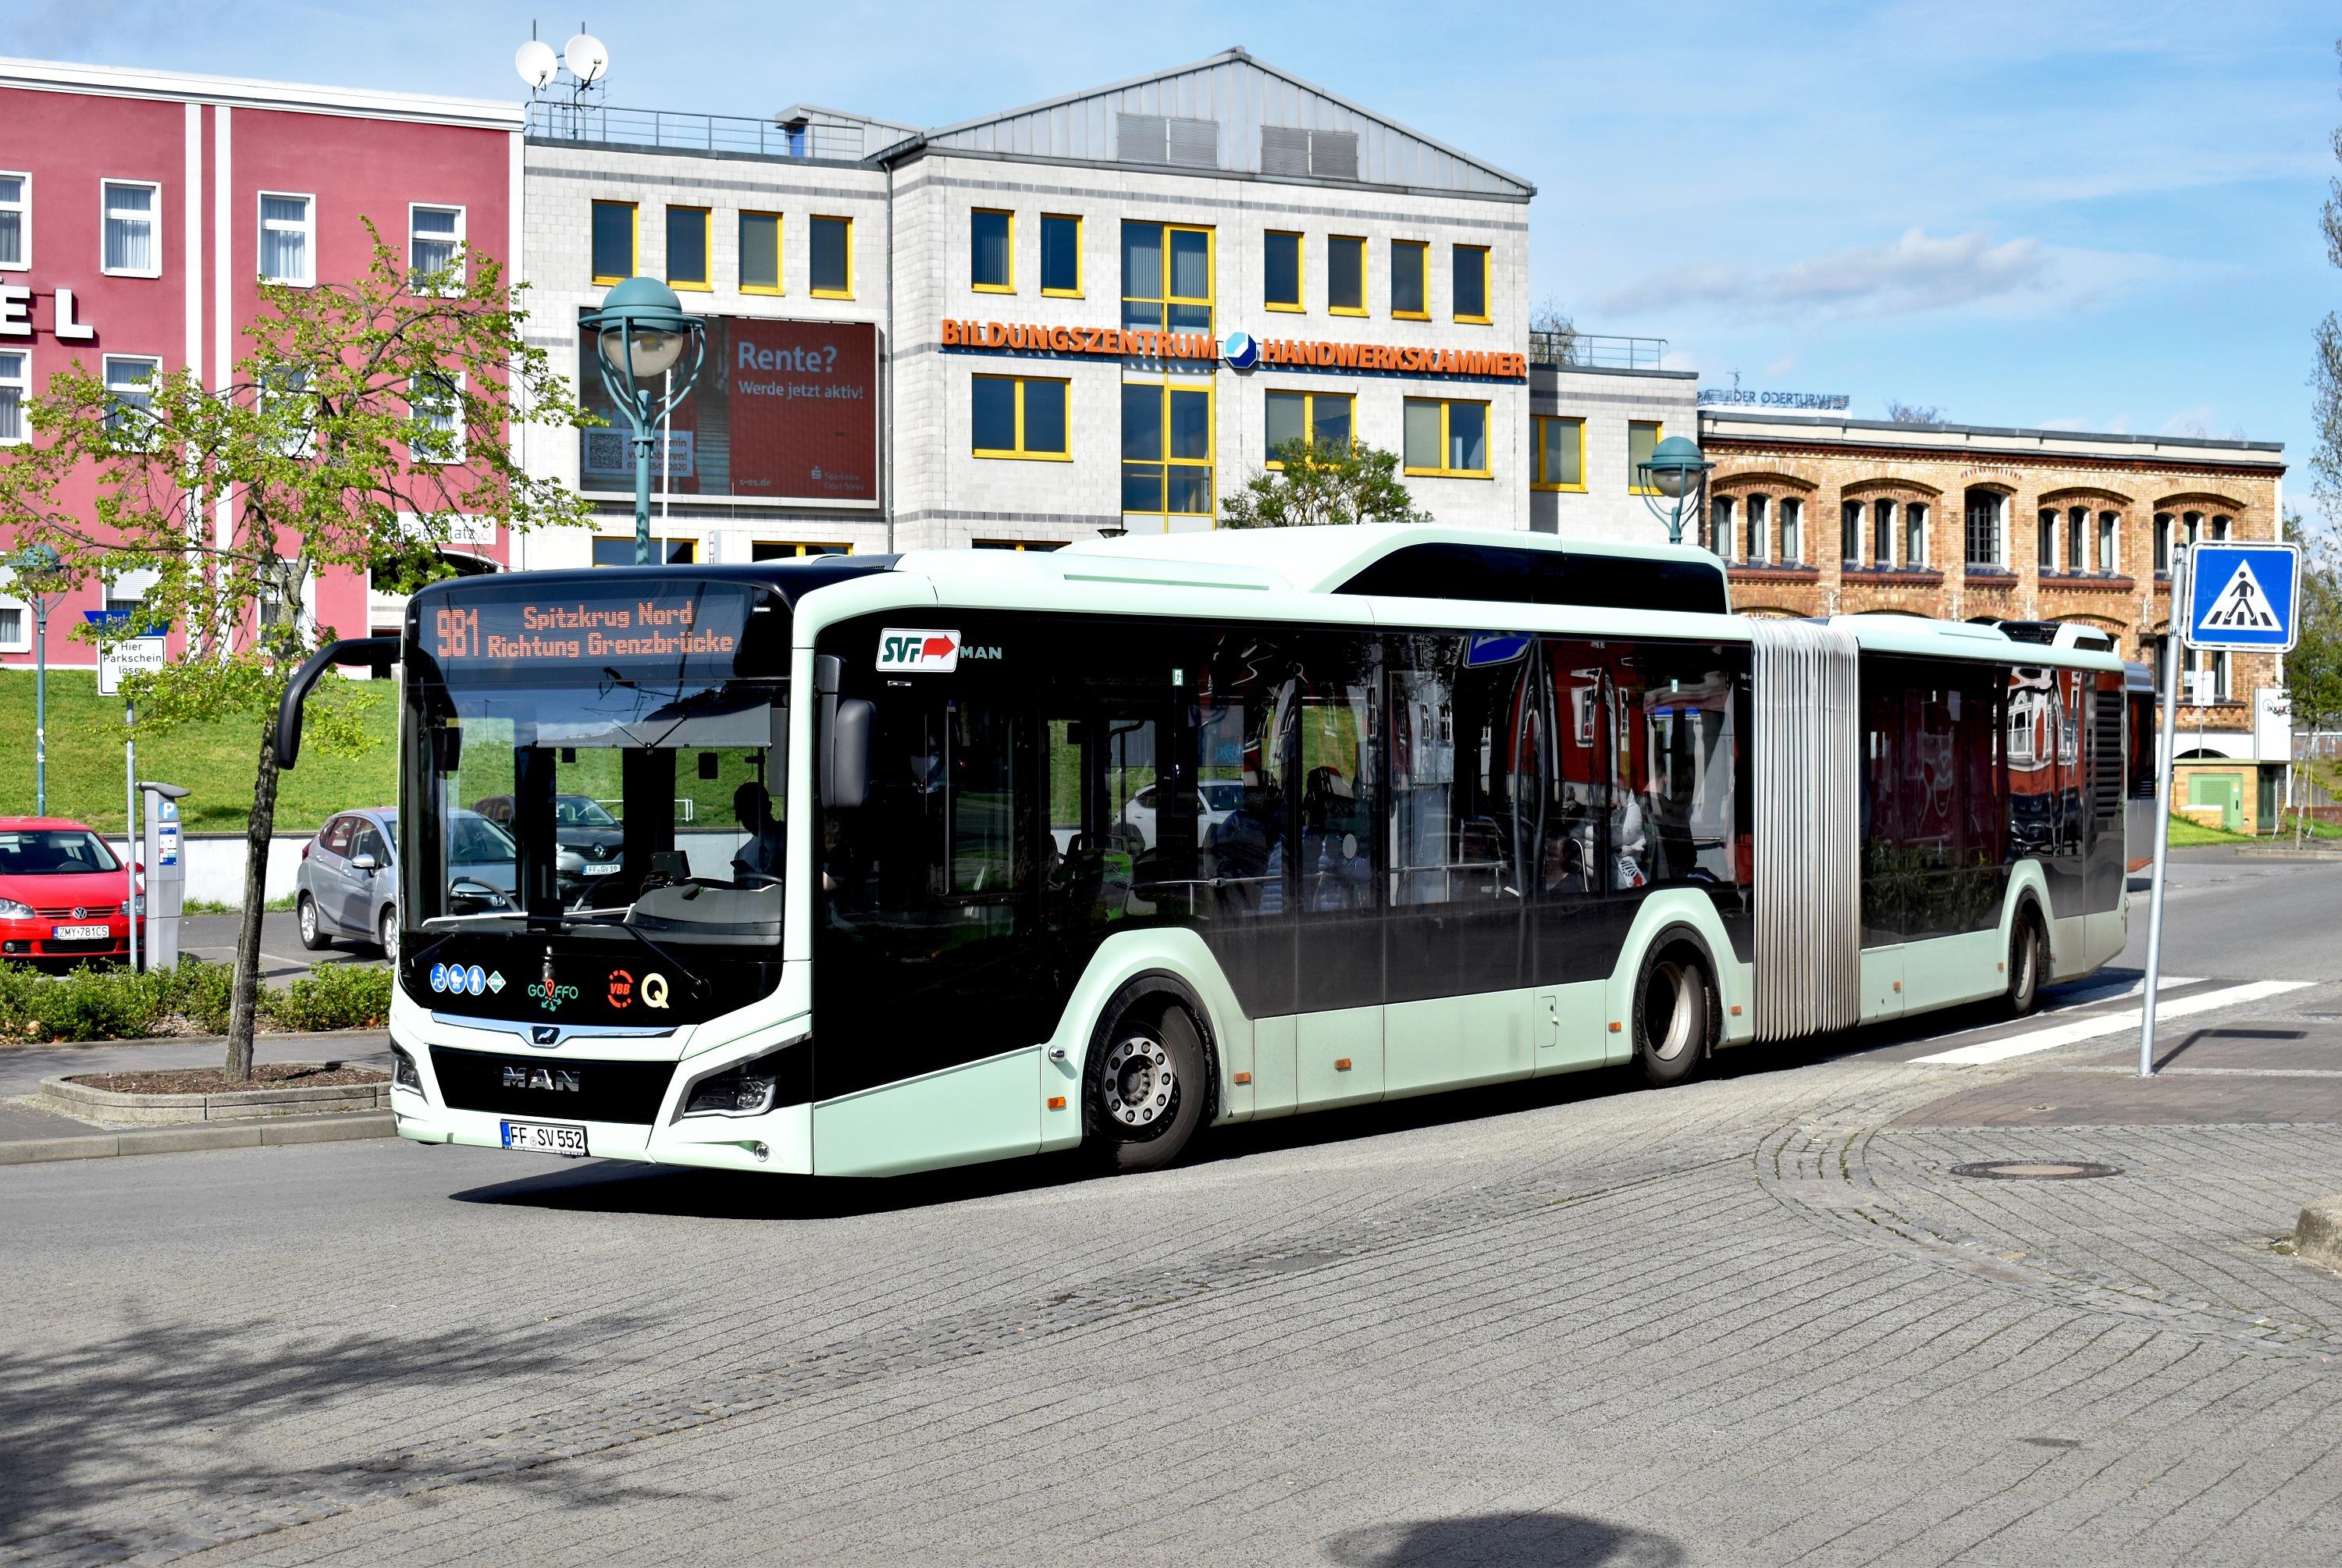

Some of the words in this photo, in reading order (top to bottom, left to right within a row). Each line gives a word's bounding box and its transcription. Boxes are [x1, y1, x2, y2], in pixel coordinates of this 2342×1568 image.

[739, 342, 837, 373] Rente?
[941, 319, 1217, 359] BILDUNGSZENTRUM
[1262, 338, 1525, 376] HANDWERKSKAMMER
[739, 381, 784, 396] Werde
[787, 382, 820, 400] jetzt
[824, 385, 863, 399] aktiv!
[1734, 390, 1756, 403] DER
[739, 478, 771, 487] s-os.de
[524, 606, 630, 631] Spitzkrug
[639, 600, 692, 625] Nord
[437, 609, 479, 657] 981
[488, 635, 579, 658] Richtung
[588, 628, 733, 655] Grenzbrücke
[121, 642, 143, 651] Hier
[882, 637, 923, 663] SVF
[960, 646, 1002, 660] MAN
[103, 653, 162, 663] Parkschein
[163, 802, 175, 820] P
[59, 928, 76, 937] ZMY
[80, 927, 108, 937] 781CS
[610, 983, 631, 995] VBB
[641, 972, 670, 1008] Q
[503, 1066, 580, 1092] MAN
[510, 1126, 527, 1144] FF
[537, 1129, 553, 1147] SV
[557, 1130, 583, 1149] 552
